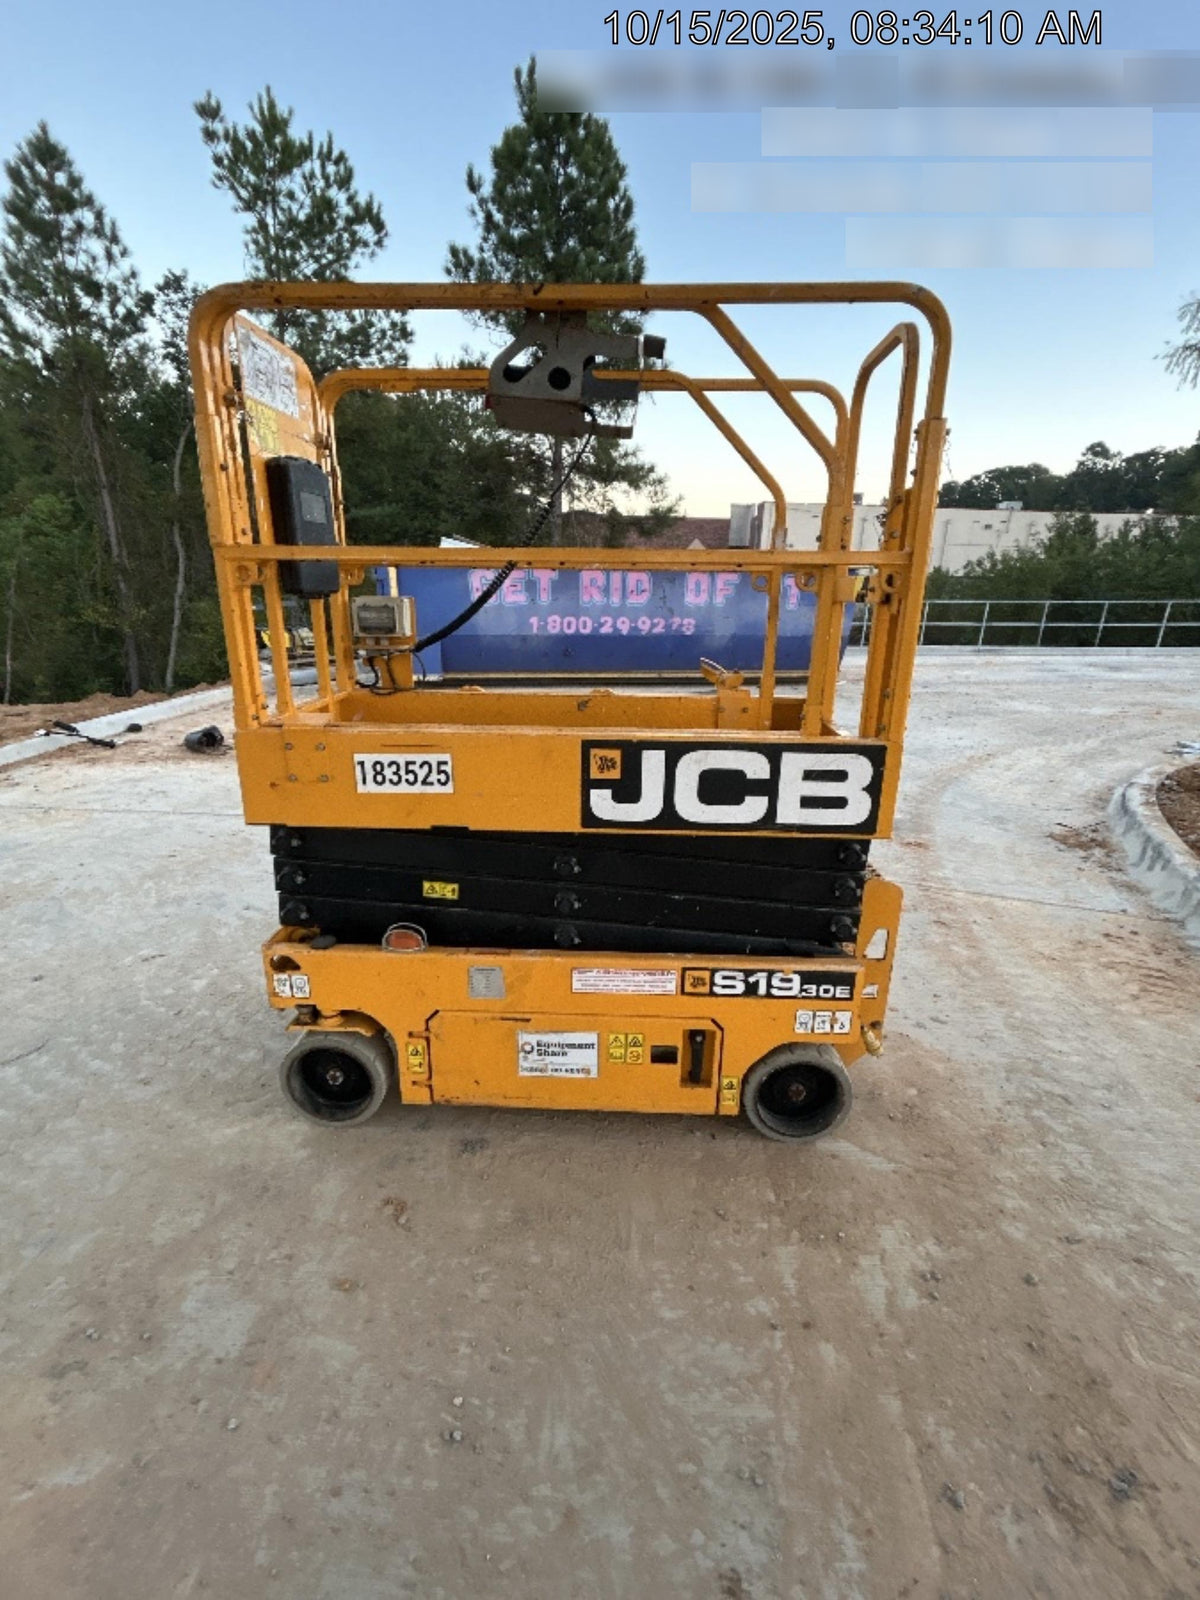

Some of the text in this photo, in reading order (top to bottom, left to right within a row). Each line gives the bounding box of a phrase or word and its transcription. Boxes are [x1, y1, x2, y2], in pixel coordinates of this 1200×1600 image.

[470, 569, 558, 604] GET
[579, 569, 652, 605] RID
[684, 571, 740, 606] OF
[357, 760, 451, 786] 183525
[589, 749, 873, 825] JCB
